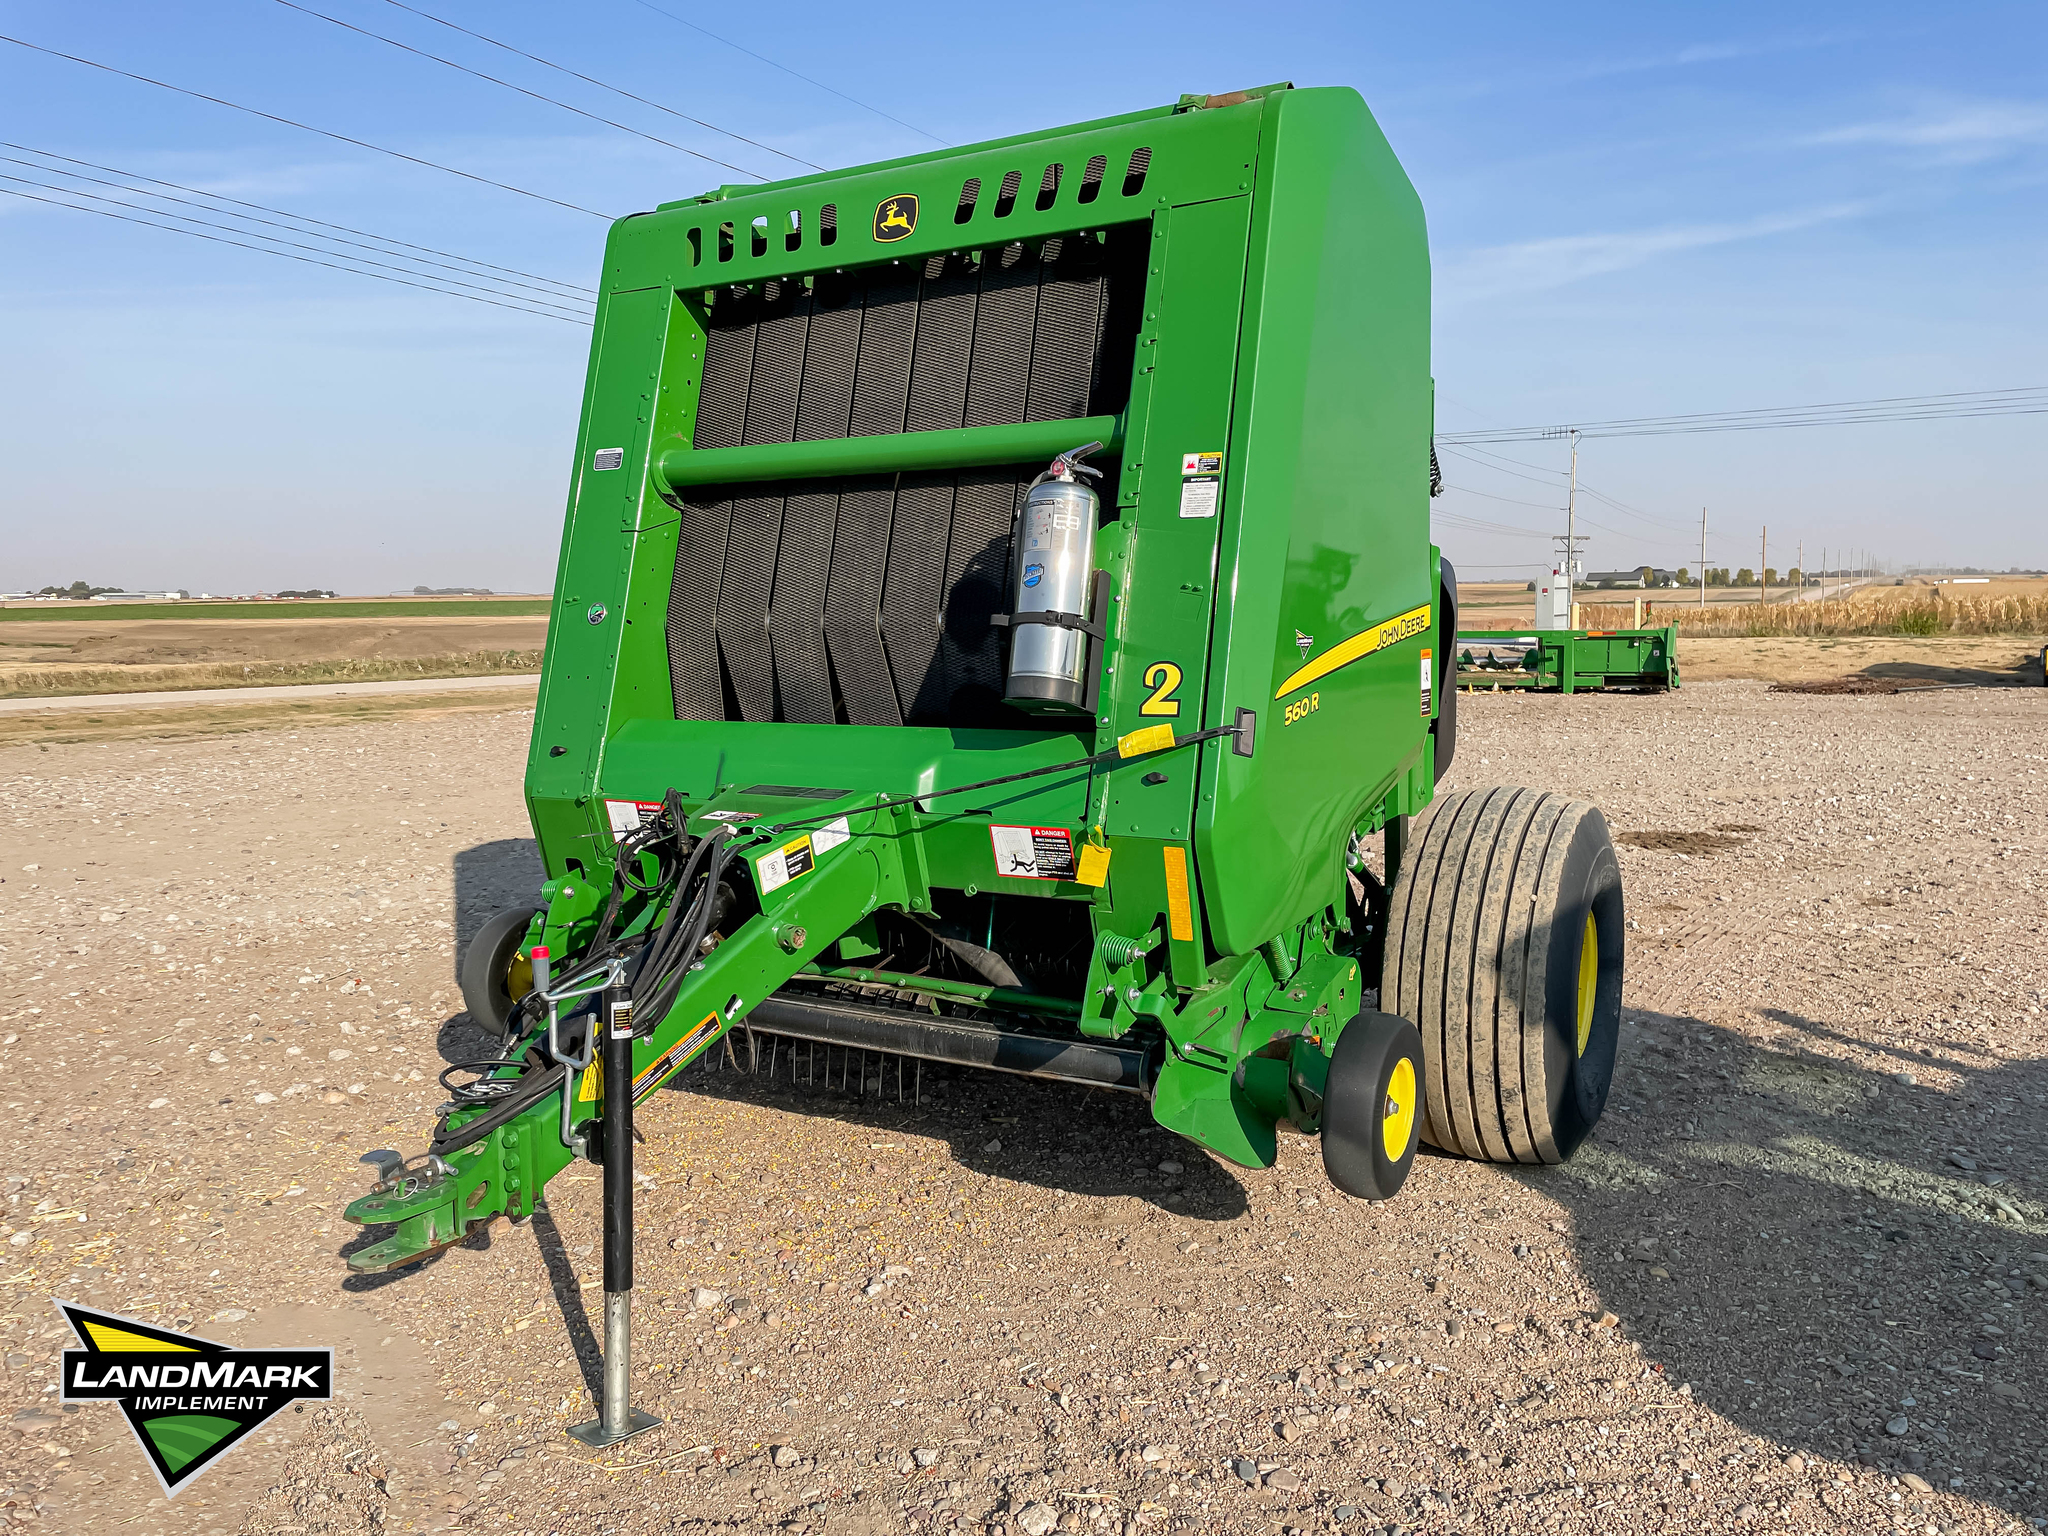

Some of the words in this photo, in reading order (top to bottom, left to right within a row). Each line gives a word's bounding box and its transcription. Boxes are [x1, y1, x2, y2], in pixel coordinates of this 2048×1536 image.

[1376, 624, 1399, 648] JOHN
[1400, 614, 1425, 637] DEERE
[1138, 660, 1184, 717] 2
[1284, 696, 1310, 727] 560
[1310, 691, 1320, 714] R
[789, 839, 807, 851] CAUTION
[1040, 829, 1066, 837] DANGER
